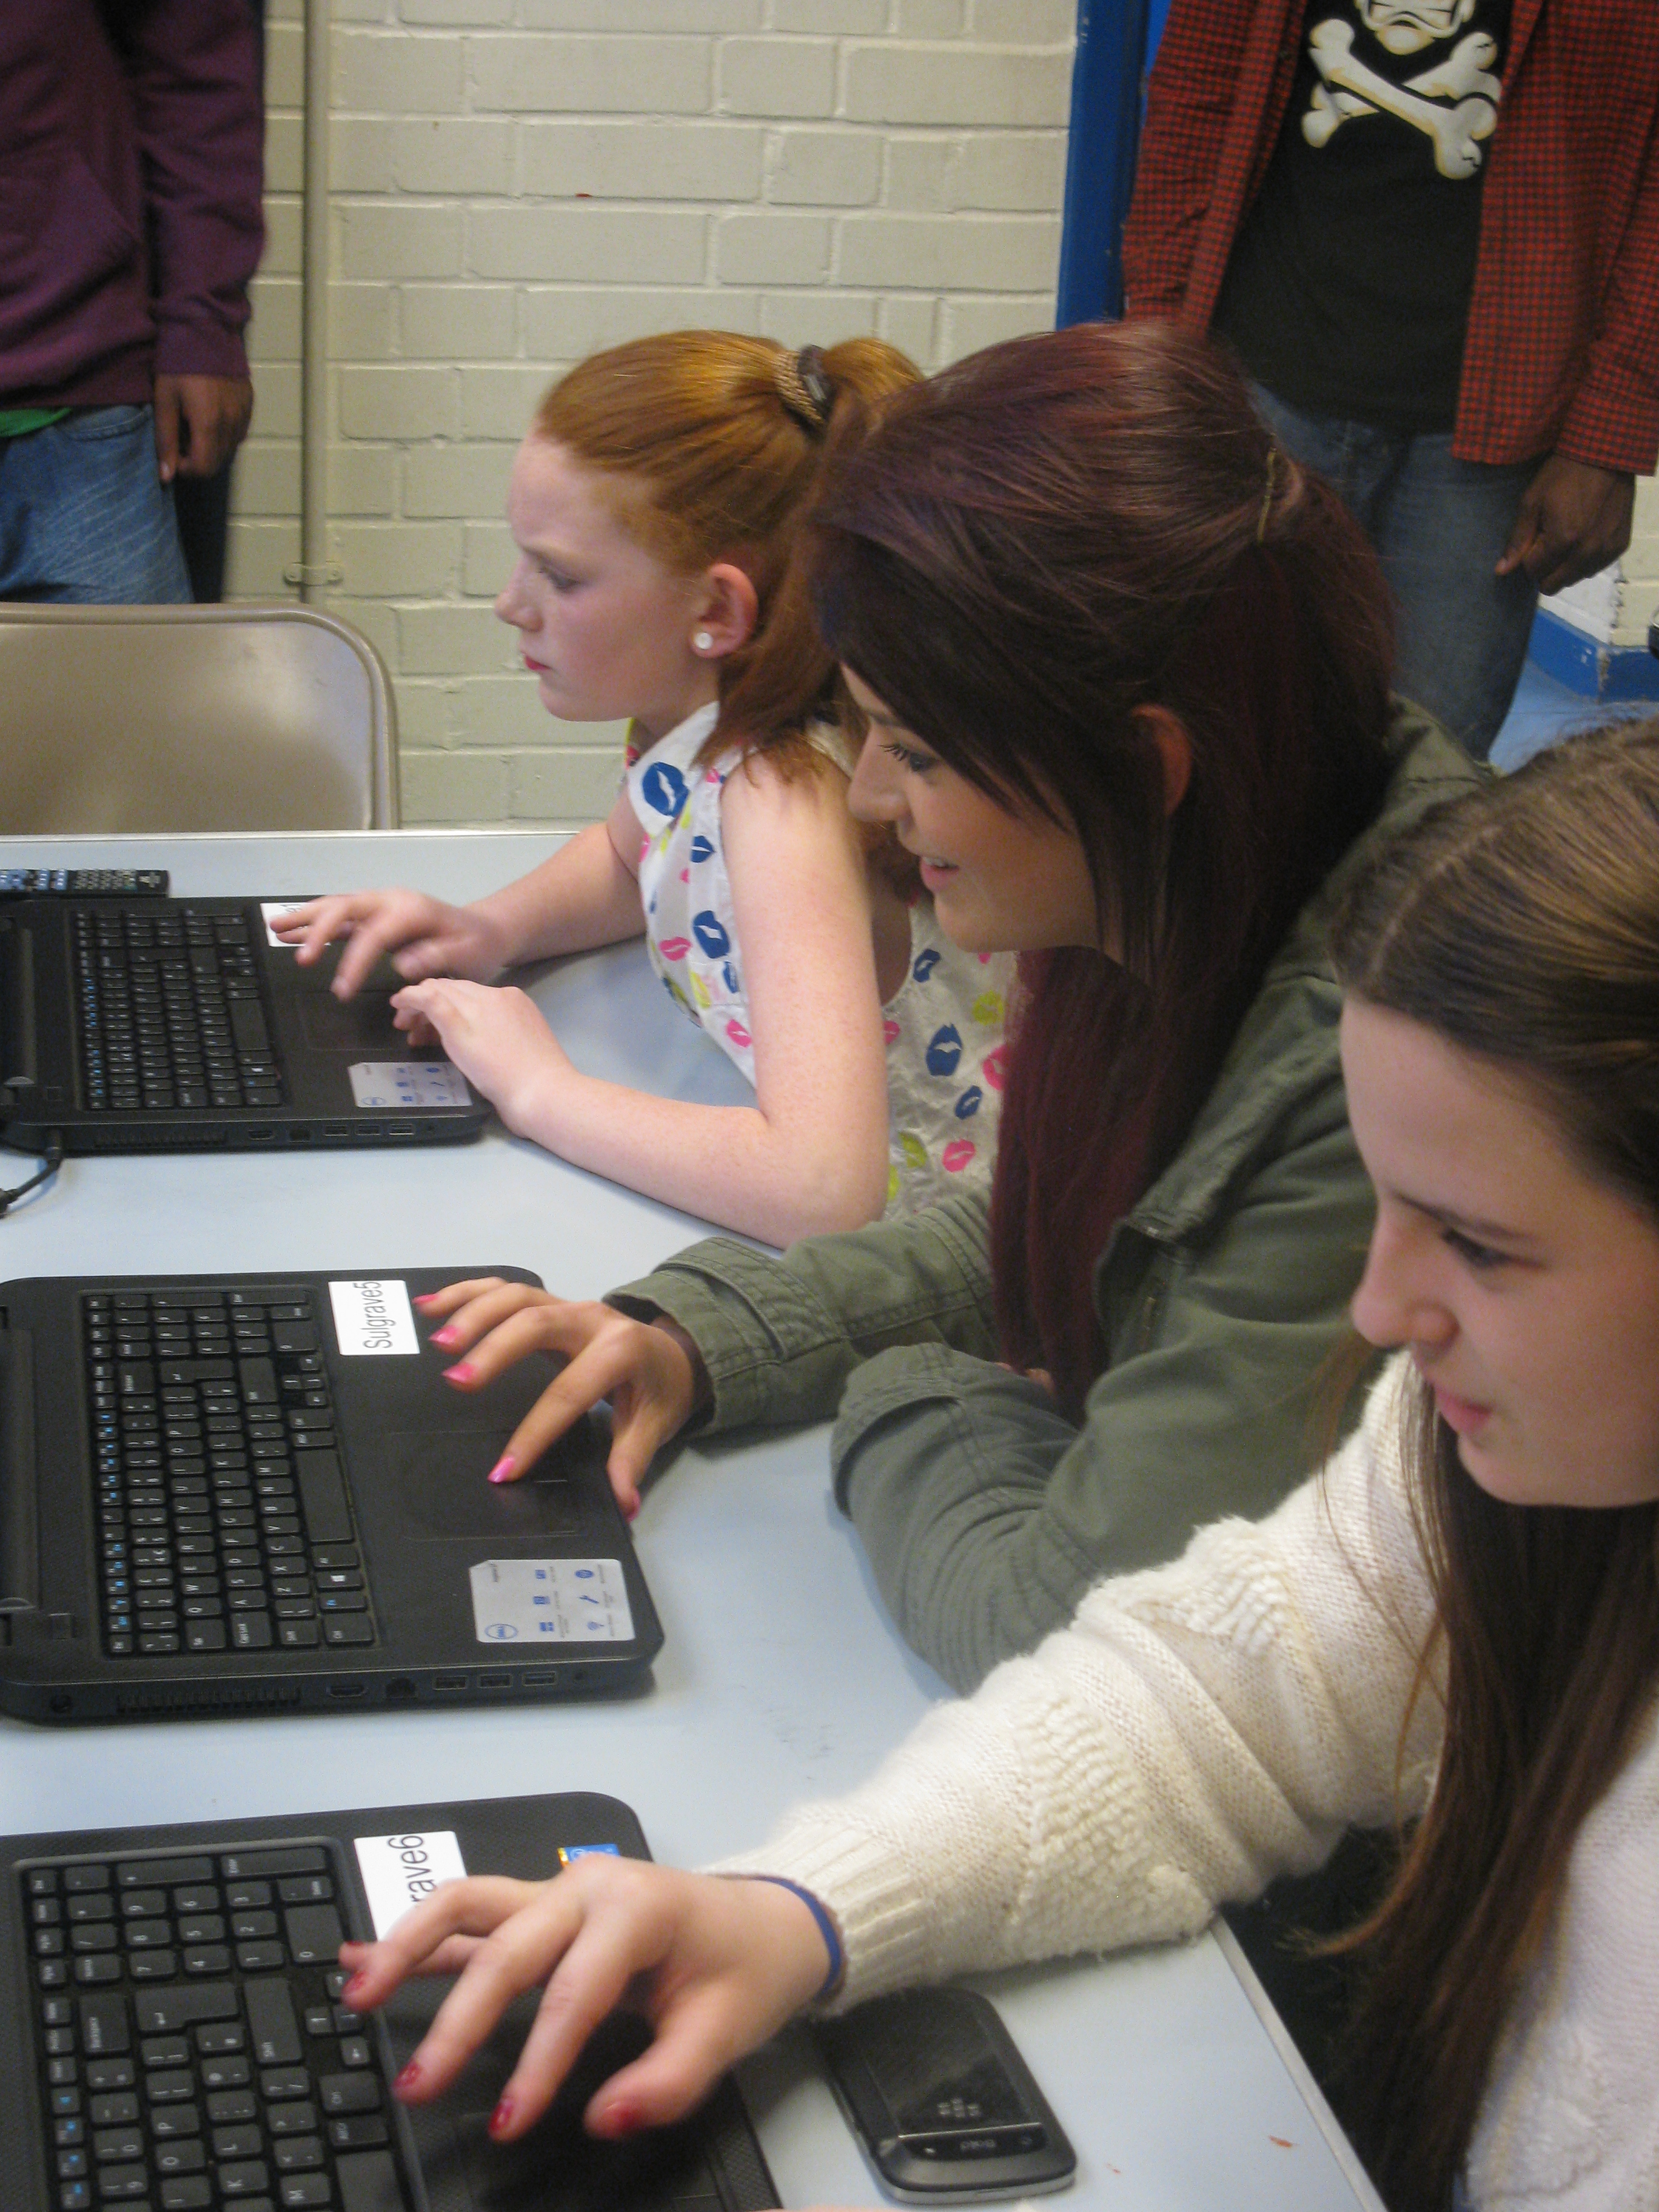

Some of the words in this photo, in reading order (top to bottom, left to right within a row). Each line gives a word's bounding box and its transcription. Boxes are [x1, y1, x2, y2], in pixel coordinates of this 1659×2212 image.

[352, 1281, 397, 1349] Sulgrave5
[226, 2180, 243, 2188] K
[288, 2190, 305, 2200] M
